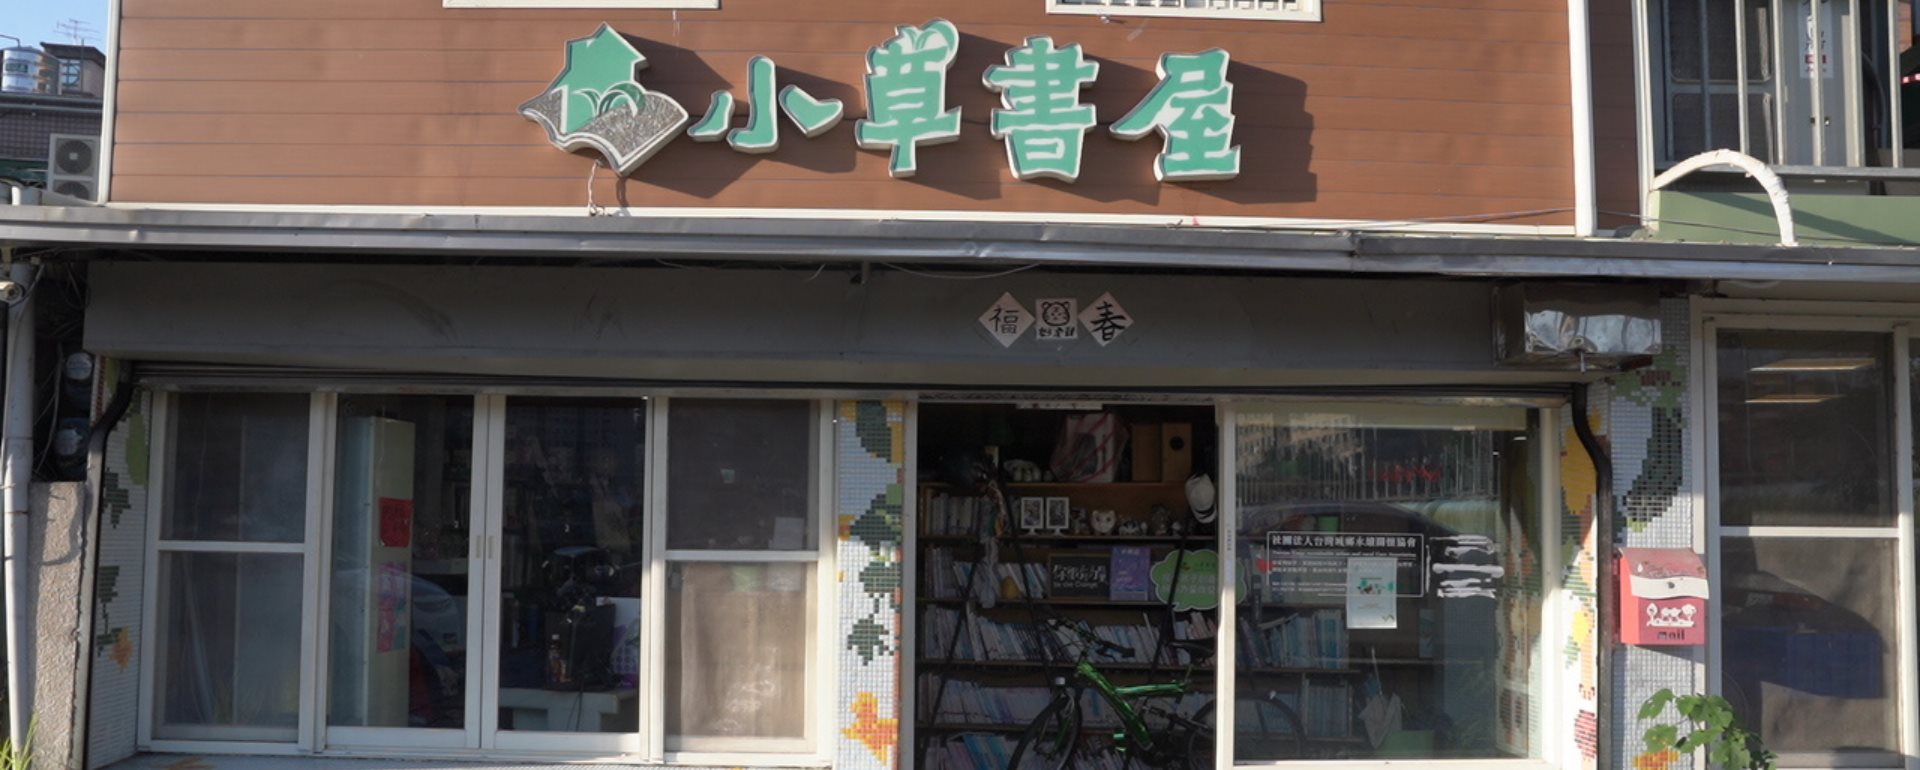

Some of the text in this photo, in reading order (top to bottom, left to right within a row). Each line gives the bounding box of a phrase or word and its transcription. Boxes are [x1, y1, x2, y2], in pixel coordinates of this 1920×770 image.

[687, 18, 1242, 183] 小草書屋
[988, 305, 1020, 334] 福
[1090, 300, 1126, 341] 春
